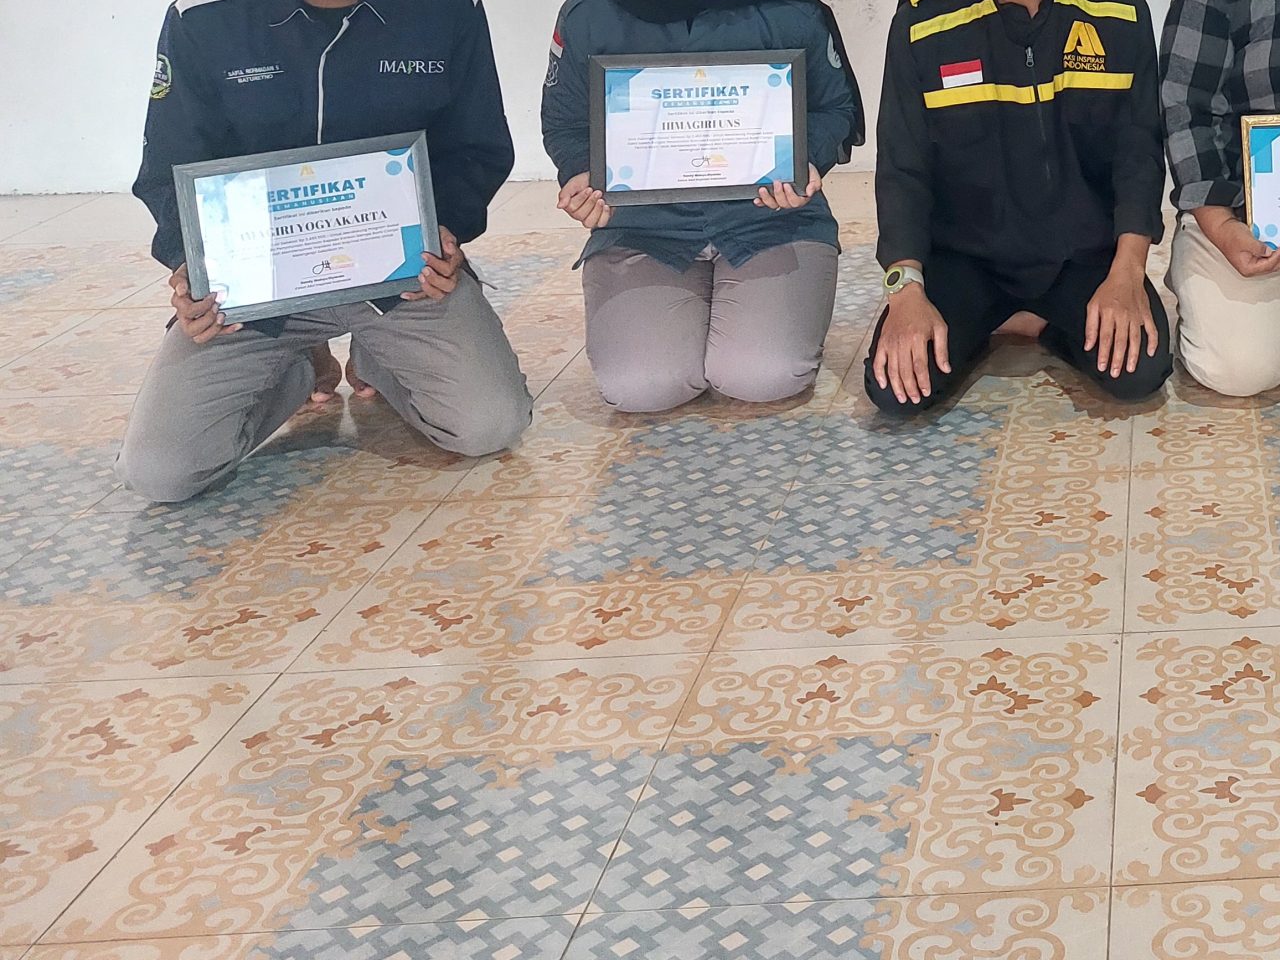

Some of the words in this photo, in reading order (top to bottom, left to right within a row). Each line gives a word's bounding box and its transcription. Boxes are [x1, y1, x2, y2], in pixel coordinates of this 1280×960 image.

[1063, 60, 1105, 71] INDONESIA
[1076, 55, 1105, 63] INSPIRASI
[379, 60, 445, 74] IMAPRES
[651, 85, 750, 99] SERTIFIKAT
[662, 119, 716, 131] HIMAGIRI
[719, 118, 741, 128] UNS
[268, 177, 366, 203] ERTIFIKAT
[272, 193, 355, 209] EMANUSIAAN
[296, 210, 388, 233] YOGYAKARTA
